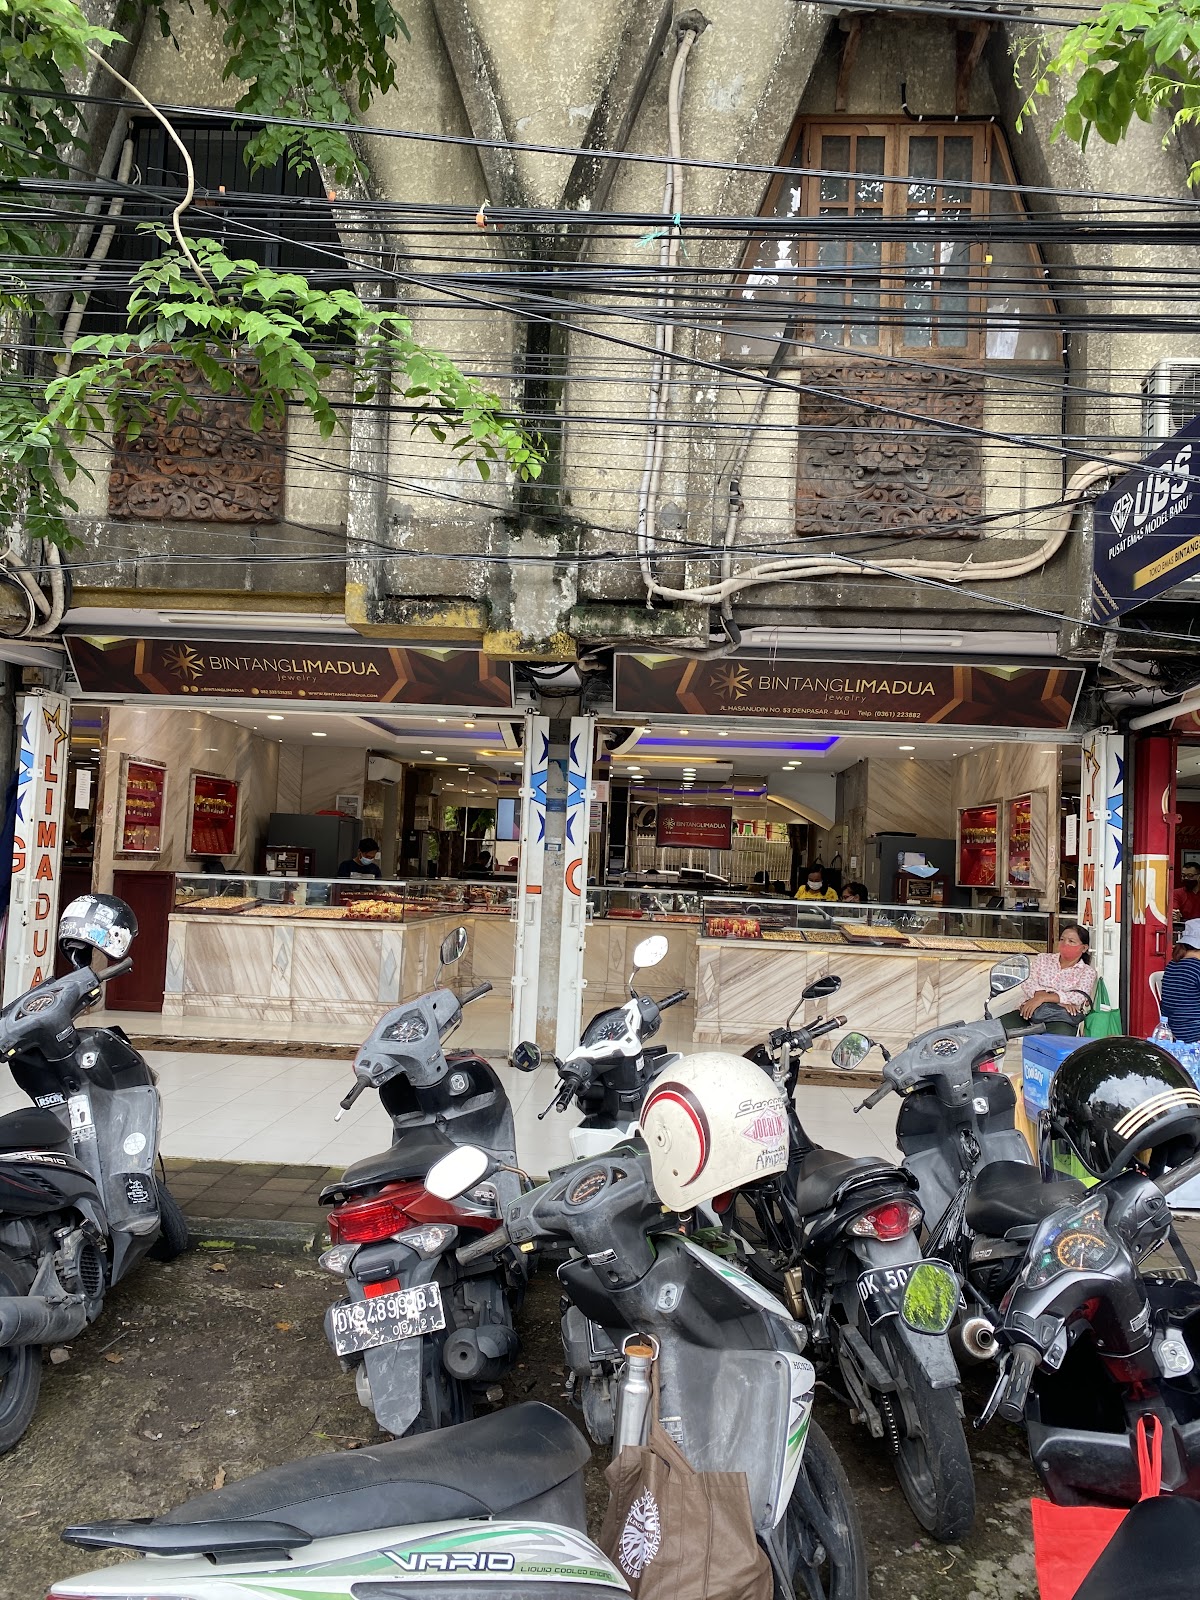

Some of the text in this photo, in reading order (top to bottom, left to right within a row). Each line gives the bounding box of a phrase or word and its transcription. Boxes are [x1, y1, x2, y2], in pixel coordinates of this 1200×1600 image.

[1133, 444, 1192, 527] UBS
[1108, 499, 1189, 560] PUSAT EMAS MODEL BARU
[1162, 555, 1174, 570] EMAS
[209, 656, 380, 676] BINTANGLIMADUA
[758, 676, 936, 696] BINTANGLIMADUA
[792, 707, 829, 715] DENPASAR
[874, 710, 895, 718] (0361)
[676, 821, 727, 829] BINTANGLIMADUA
[24, 1154, 67, 1166] VARIO
[859, 1267, 913, 1301] DK 50
[337, 1307, 357, 1333] DK
[367, 1294, 408, 1323] 4899
[383, 1551, 515, 1573] VARIO
[520, 1566, 552, 1574] LIQUID
[554, 1567, 588, 1576] COOLED
